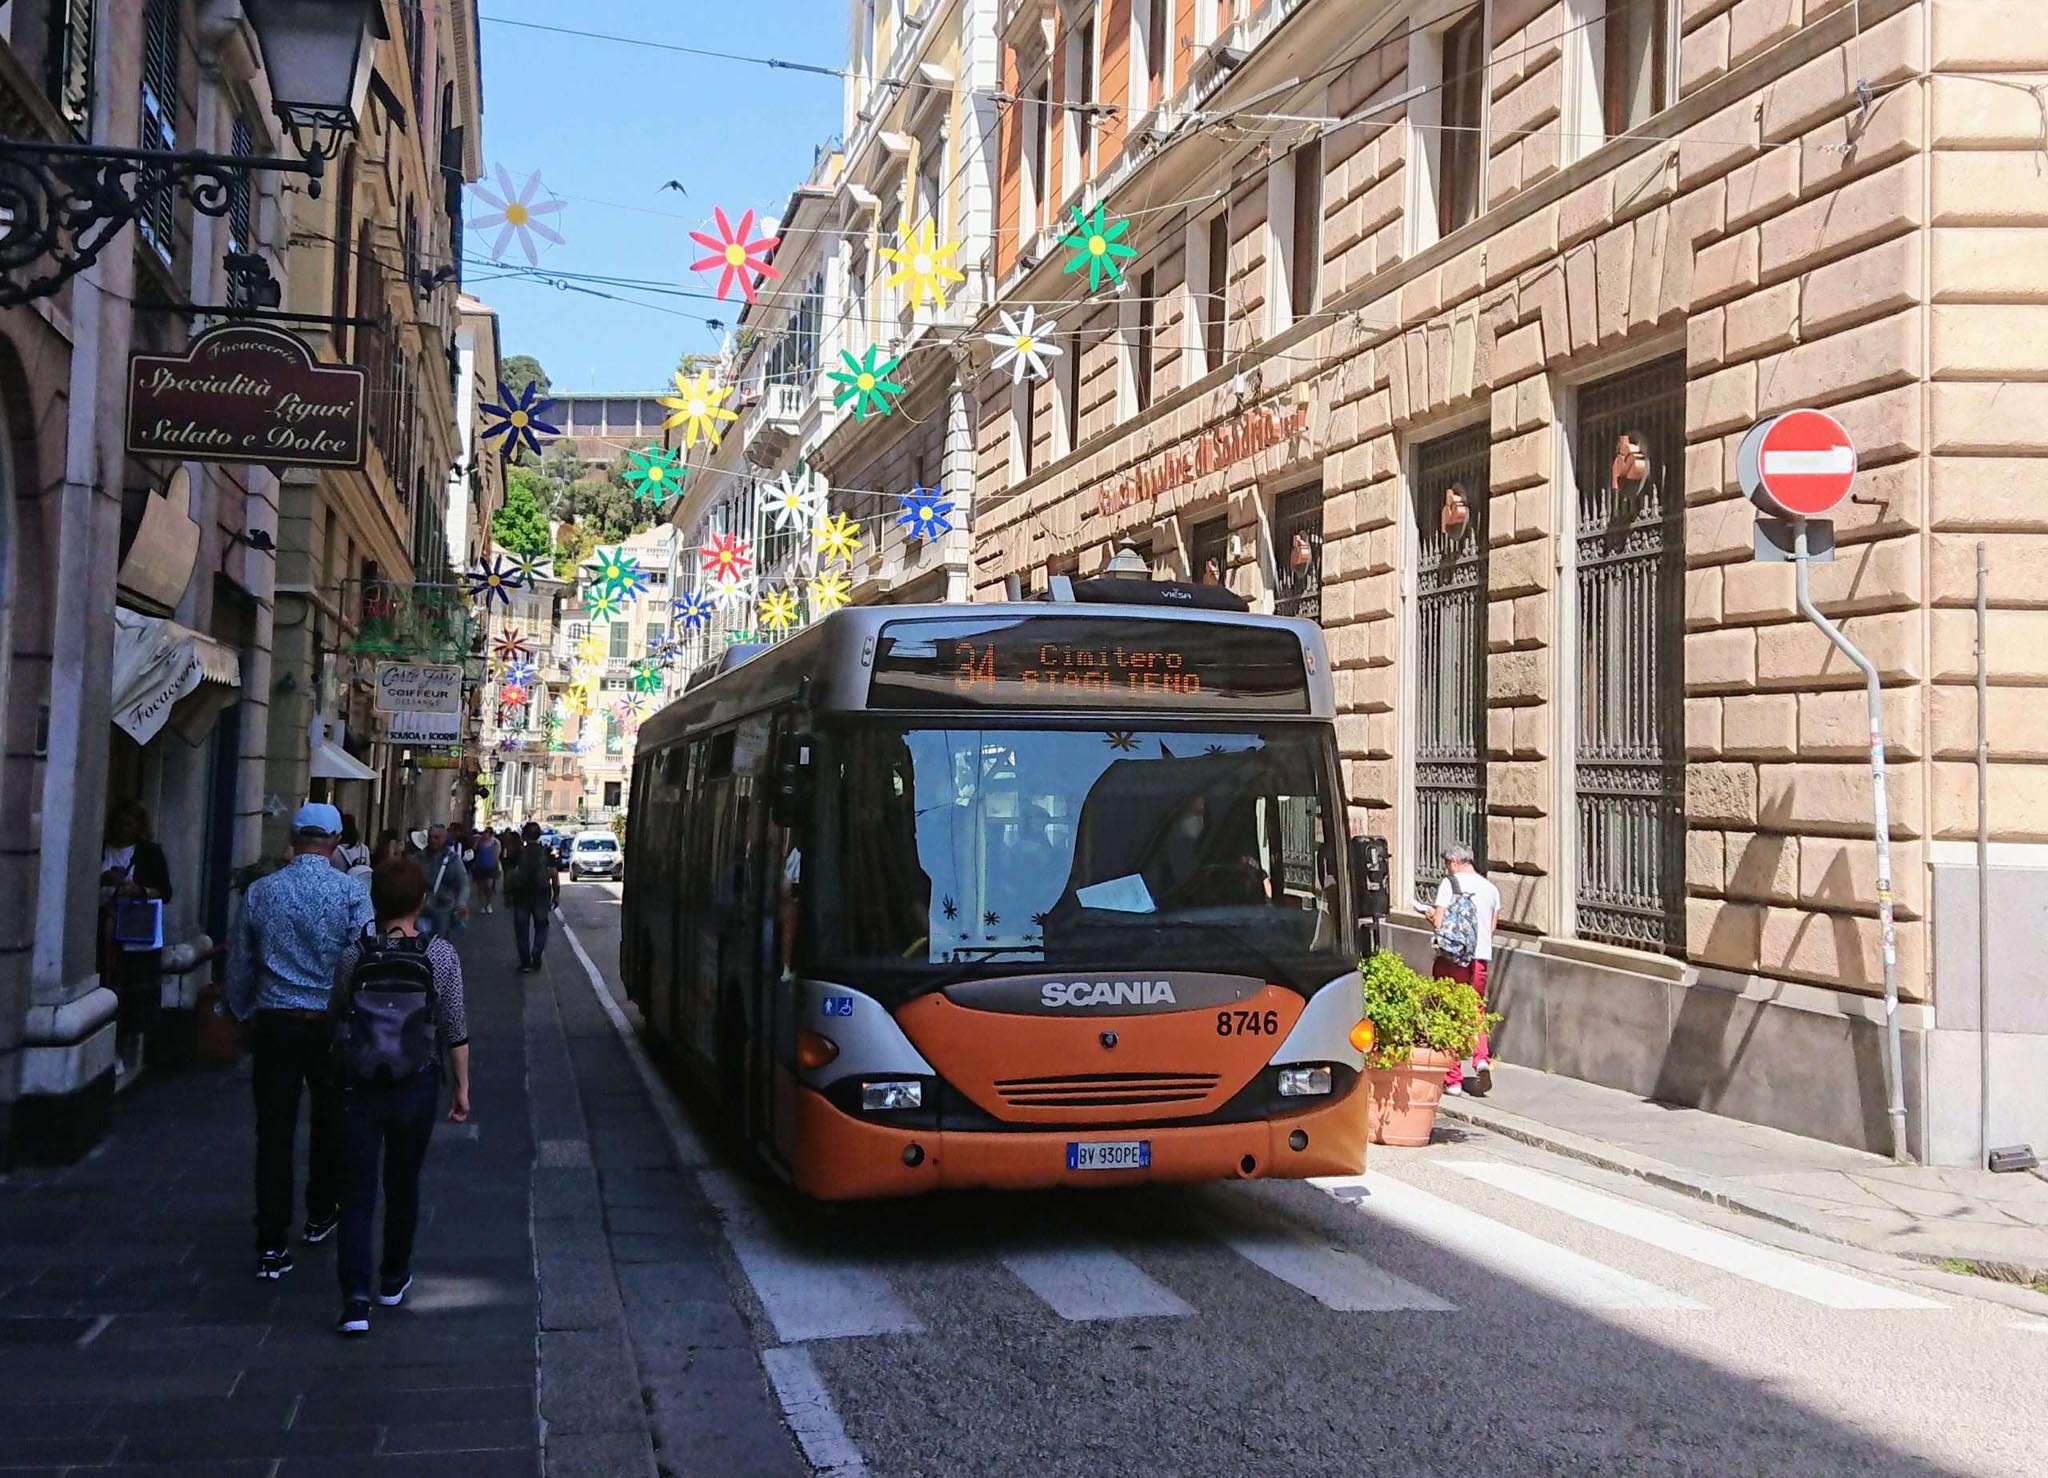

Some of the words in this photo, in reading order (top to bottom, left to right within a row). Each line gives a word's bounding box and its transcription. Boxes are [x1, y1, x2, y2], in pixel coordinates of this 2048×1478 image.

[207, 341, 297, 364] Focacceria
[140, 367, 272, 397] Specialità
[264, 392, 354, 423] Liguri
[141, 419, 232, 446] Salato
[242, 433, 256, 447] e
[264, 426, 347, 452] Dolce
[955, 642, 996, 693] 34
[1040, 644, 1183, 669] Cimitero
[388, 688, 448, 698] COIFFEUR
[1041, 981, 1176, 1007] SCANIA
[1216, 1011, 1279, 1036] 8746
[1080, 1148, 1095, 1164] BV
[1099, 1147, 1139, 1164] 930PE
